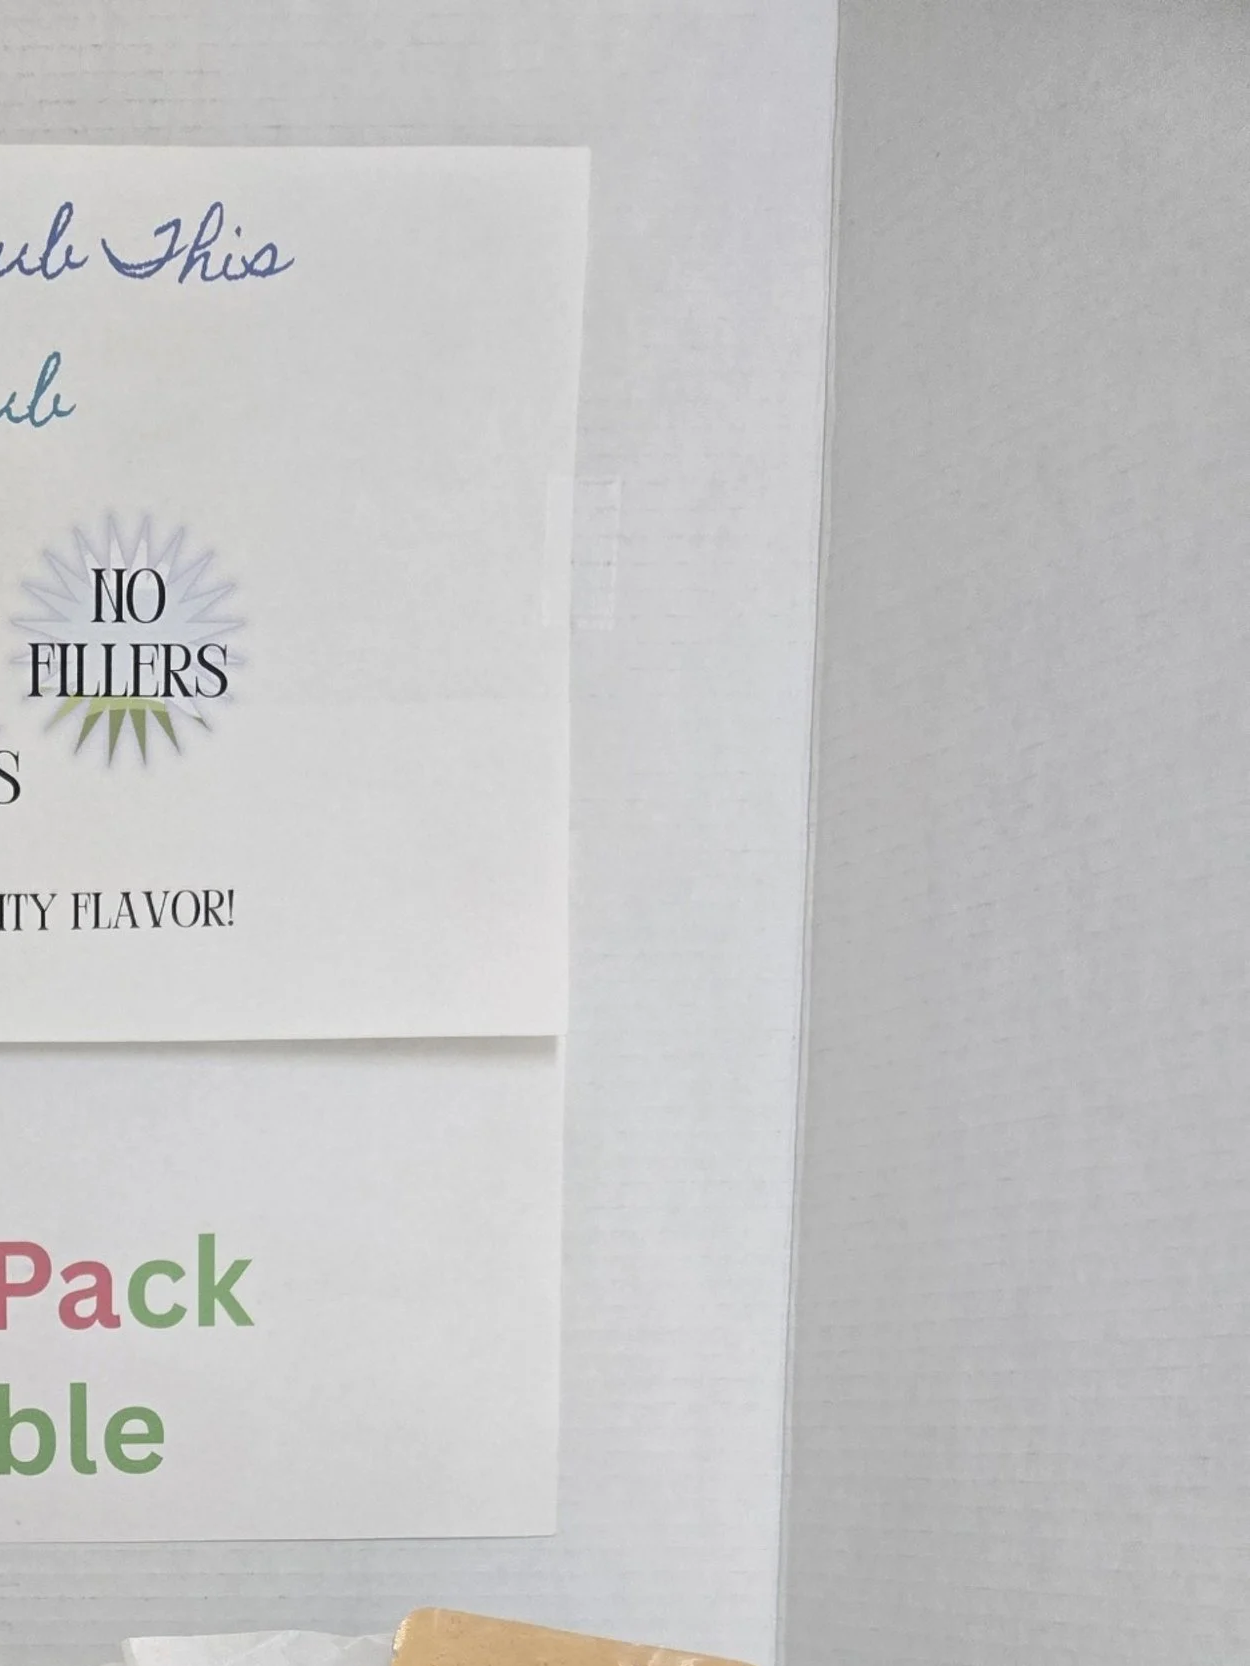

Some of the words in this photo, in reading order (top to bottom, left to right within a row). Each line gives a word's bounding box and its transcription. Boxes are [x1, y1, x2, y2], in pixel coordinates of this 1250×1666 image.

[100, 202, 295, 284] This
[91, 568, 167, 624] NO
[27, 643, 230, 699] FILLERS
[71, 889, 236, 932] FLAVOR!
